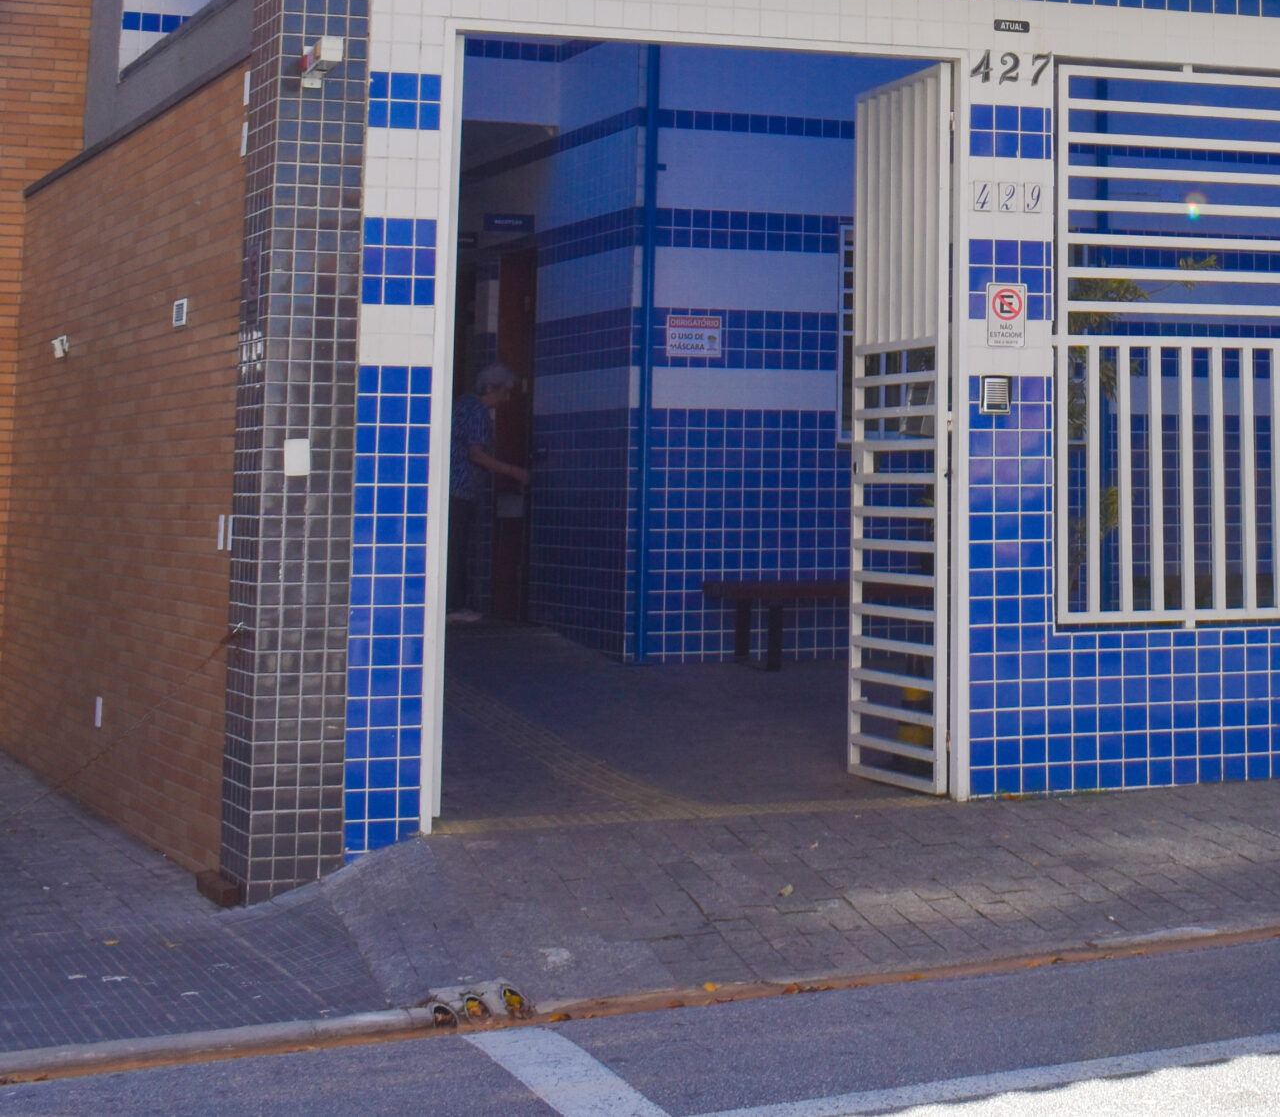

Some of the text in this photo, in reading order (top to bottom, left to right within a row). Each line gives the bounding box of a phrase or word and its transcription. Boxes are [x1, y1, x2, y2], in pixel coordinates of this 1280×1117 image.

[1000, 21, 1024, 32] ATUAL
[970, 49, 1053, 87] 427
[975, 183, 1041, 211] 429
[1000, 322, 1013, 330] NÃO
[989, 331, 1023, 339] ESTACIONE
